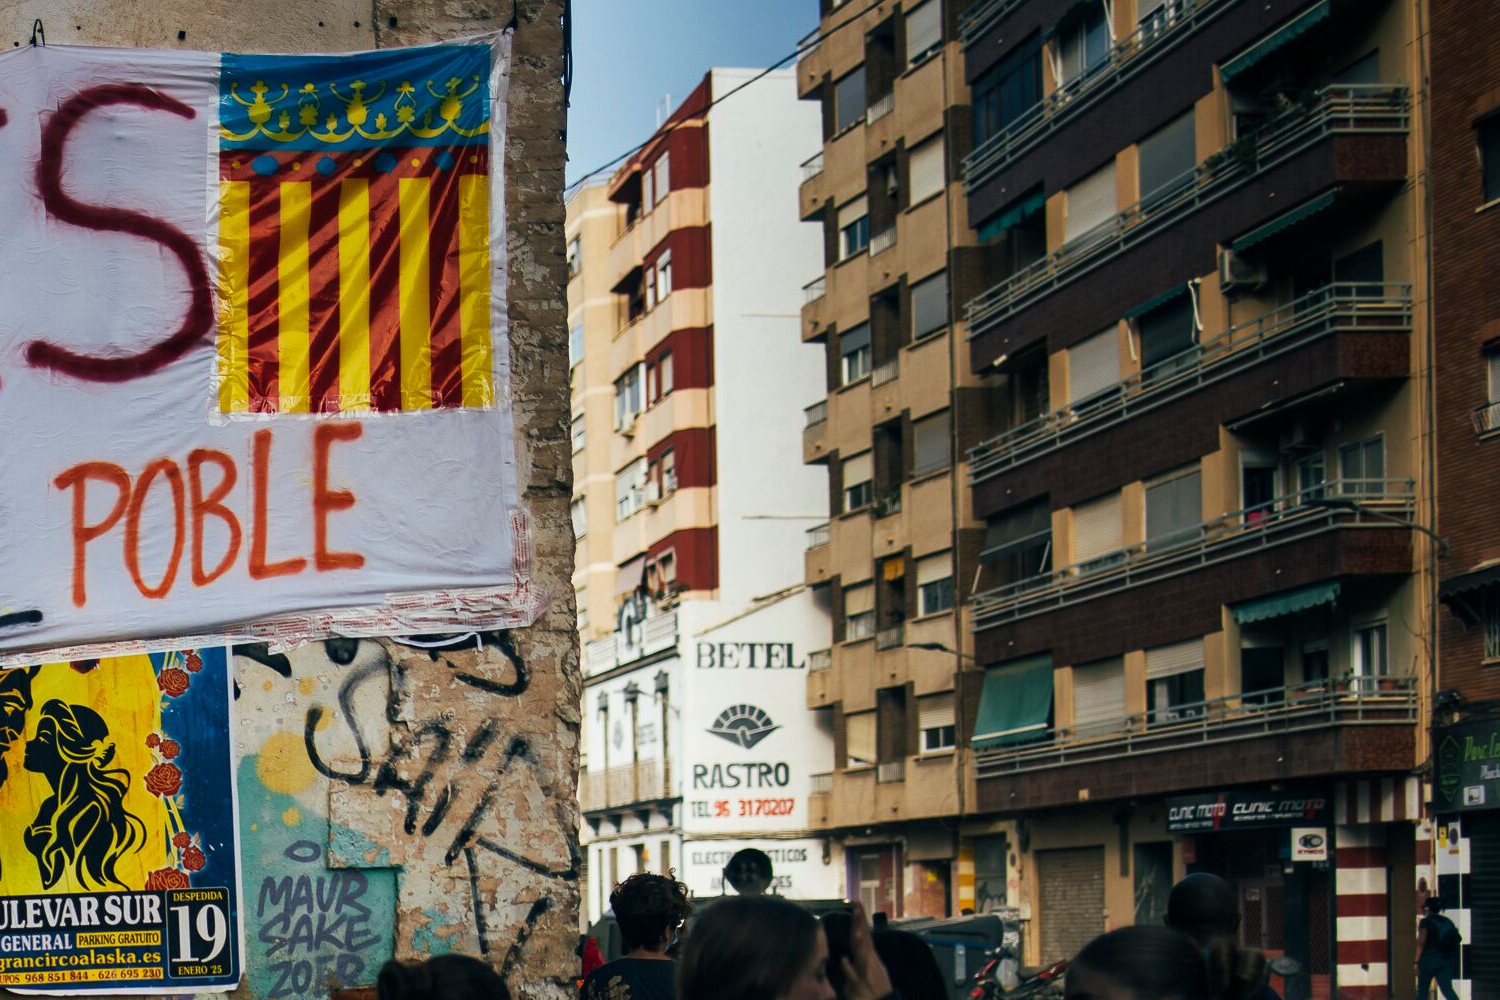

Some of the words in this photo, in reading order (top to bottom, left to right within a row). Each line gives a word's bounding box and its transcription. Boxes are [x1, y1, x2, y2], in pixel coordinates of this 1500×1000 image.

[50, 421, 367, 609] POBLE
[696, 641, 806, 670] BETEL
[692, 761, 790, 790] RASTRO
[691, 801, 712, 817] TEL
[739, 798, 795, 817] 3170207
[1232, 801, 1275, 815] CLINIC
[1278, 798, 1326, 812] MOTO
[173, 891, 223, 902] DESPEDIDA
[104, 894, 163, 925] SUR
[0, 933, 72, 953] GENERAL
[78, 934, 116, 946] PARKING
[117, 931, 160, 944] GRATUITO
[169, 903, 227, 964] 19
[25, 974, 44, 983] 968
[47, 973, 66, 983] 851
[69, 971, 89, 982] 844
[98, 970, 117, 980] 626
[120, 969, 139, 979] 695
[142, 968, 161, 979] 230
[178, 966, 208, 976] ENERO
